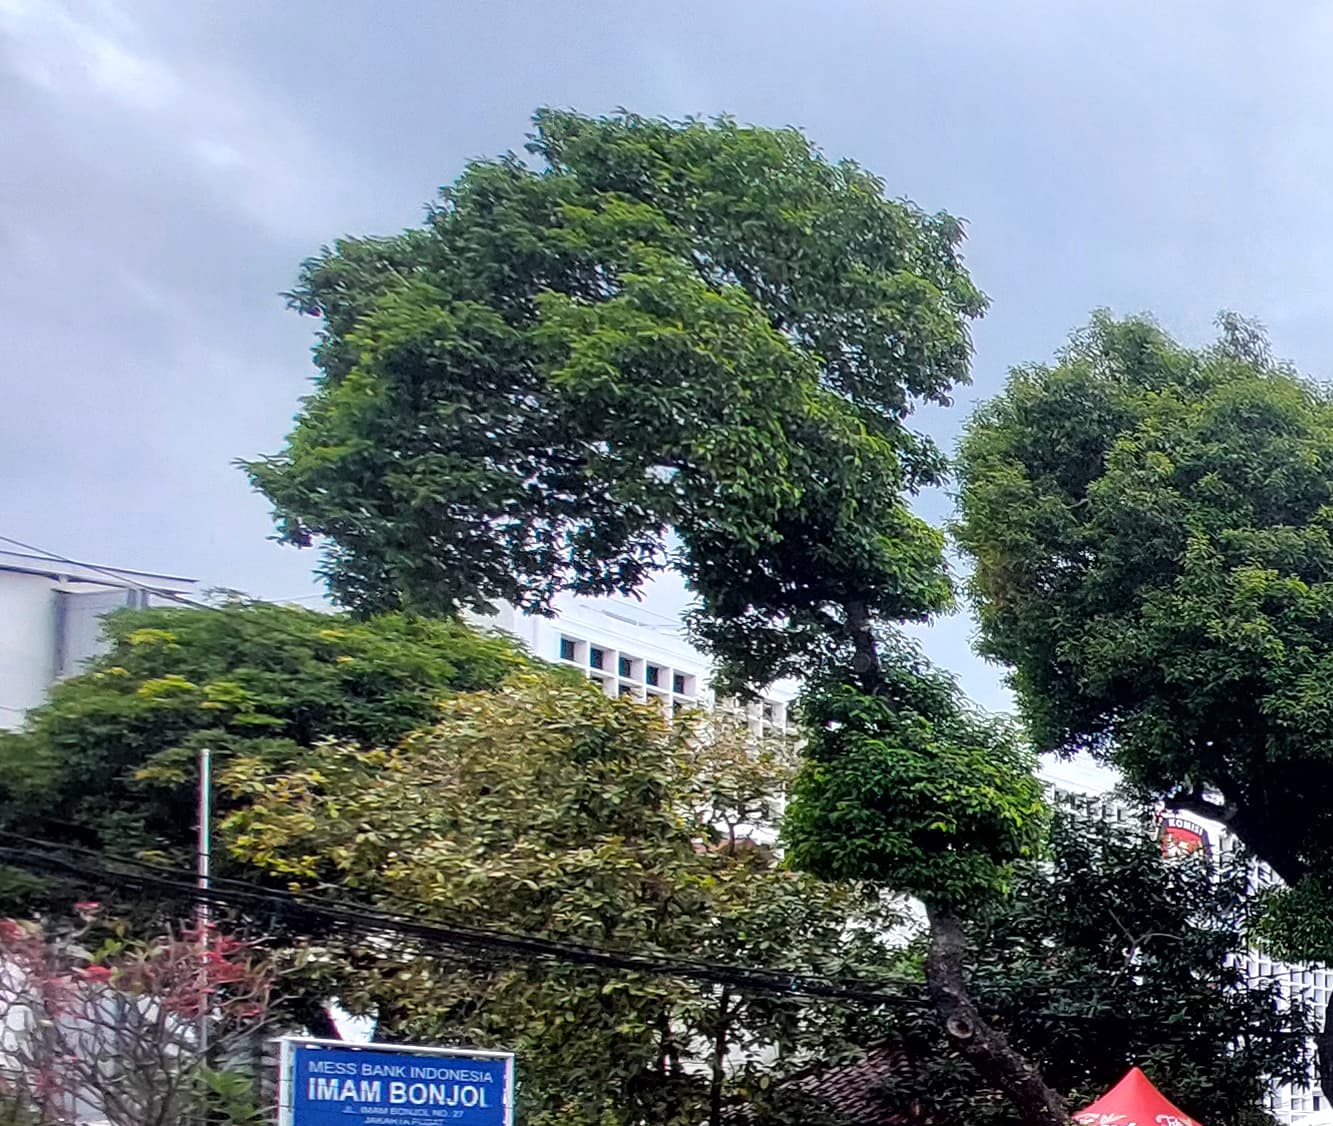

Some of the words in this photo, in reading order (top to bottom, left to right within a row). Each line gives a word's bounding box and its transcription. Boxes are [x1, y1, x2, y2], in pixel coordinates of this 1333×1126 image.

[1168, 818, 1204, 836] KOMISI
[308, 1060, 358, 1075] MESS
[361, 1063, 406, 1079] BANK
[410, 1066, 494, 1083] INDONESIA
[308, 1077, 382, 1102] IMAM
[389, 1081, 492, 1109] BONJOL
